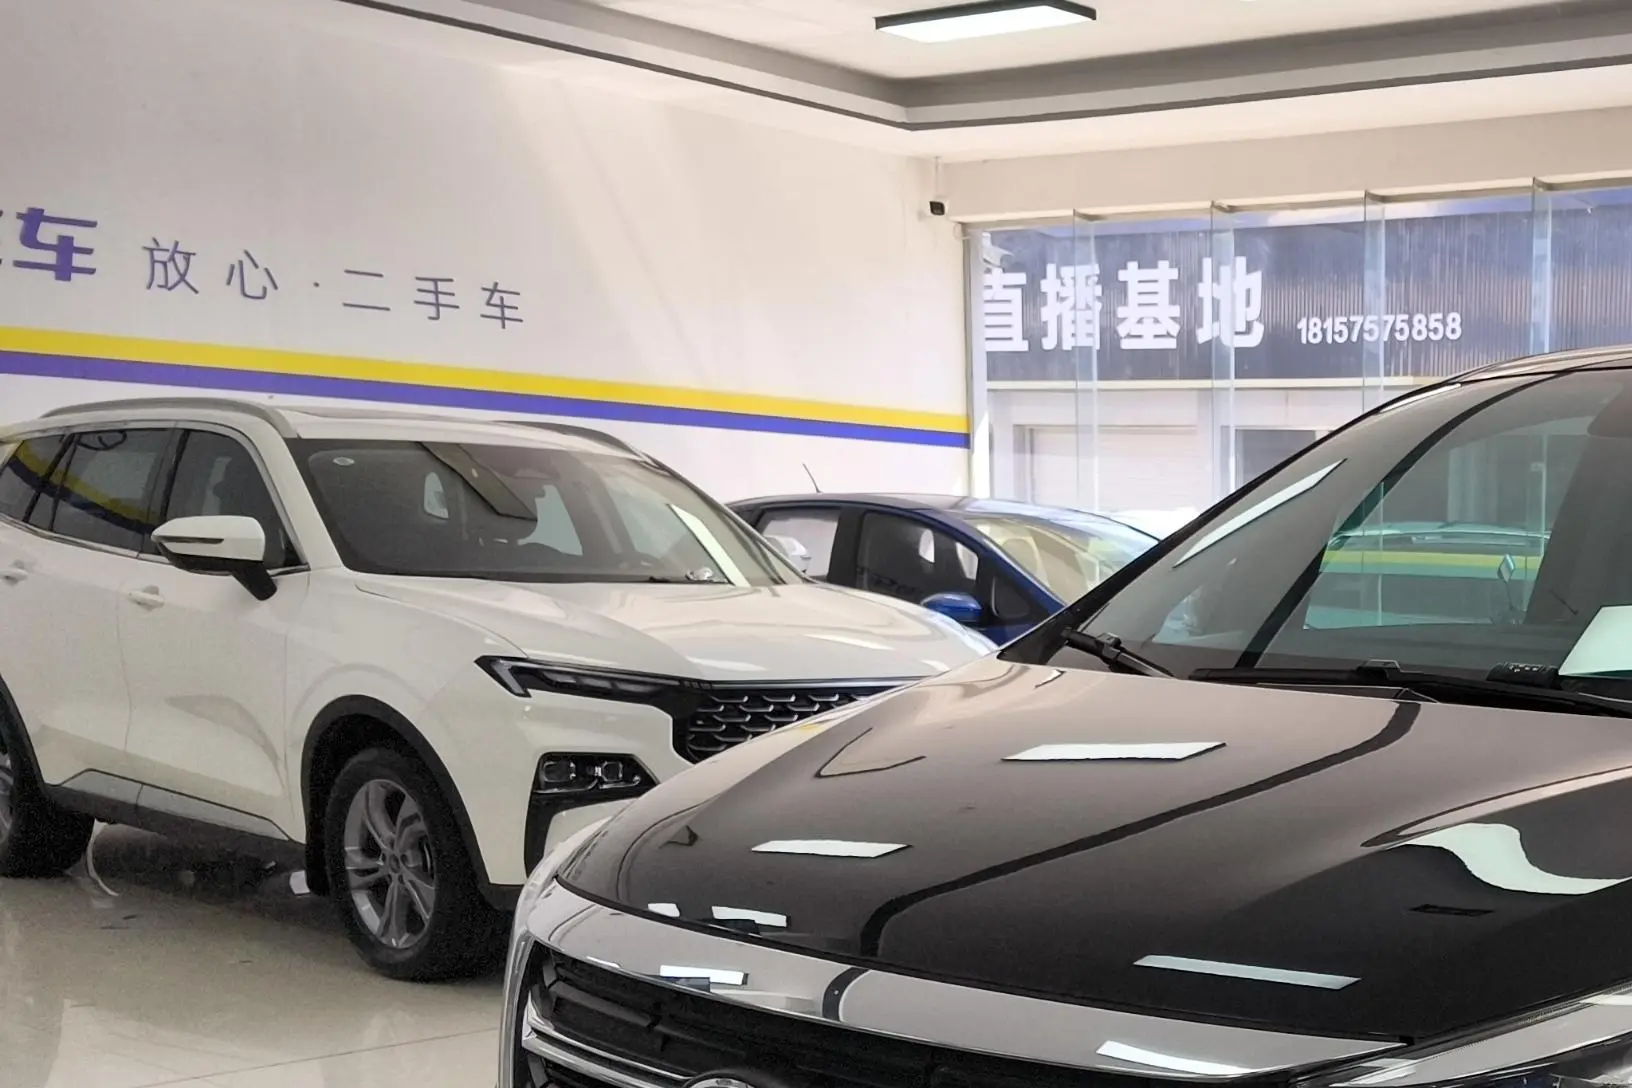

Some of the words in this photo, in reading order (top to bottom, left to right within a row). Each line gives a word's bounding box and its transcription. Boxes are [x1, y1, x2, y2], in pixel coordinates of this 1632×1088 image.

[0, 207, 98, 283] 车
[983, 256, 1265, 352] 直播基地
[1296, 311, 1463, 345] 18157575858
